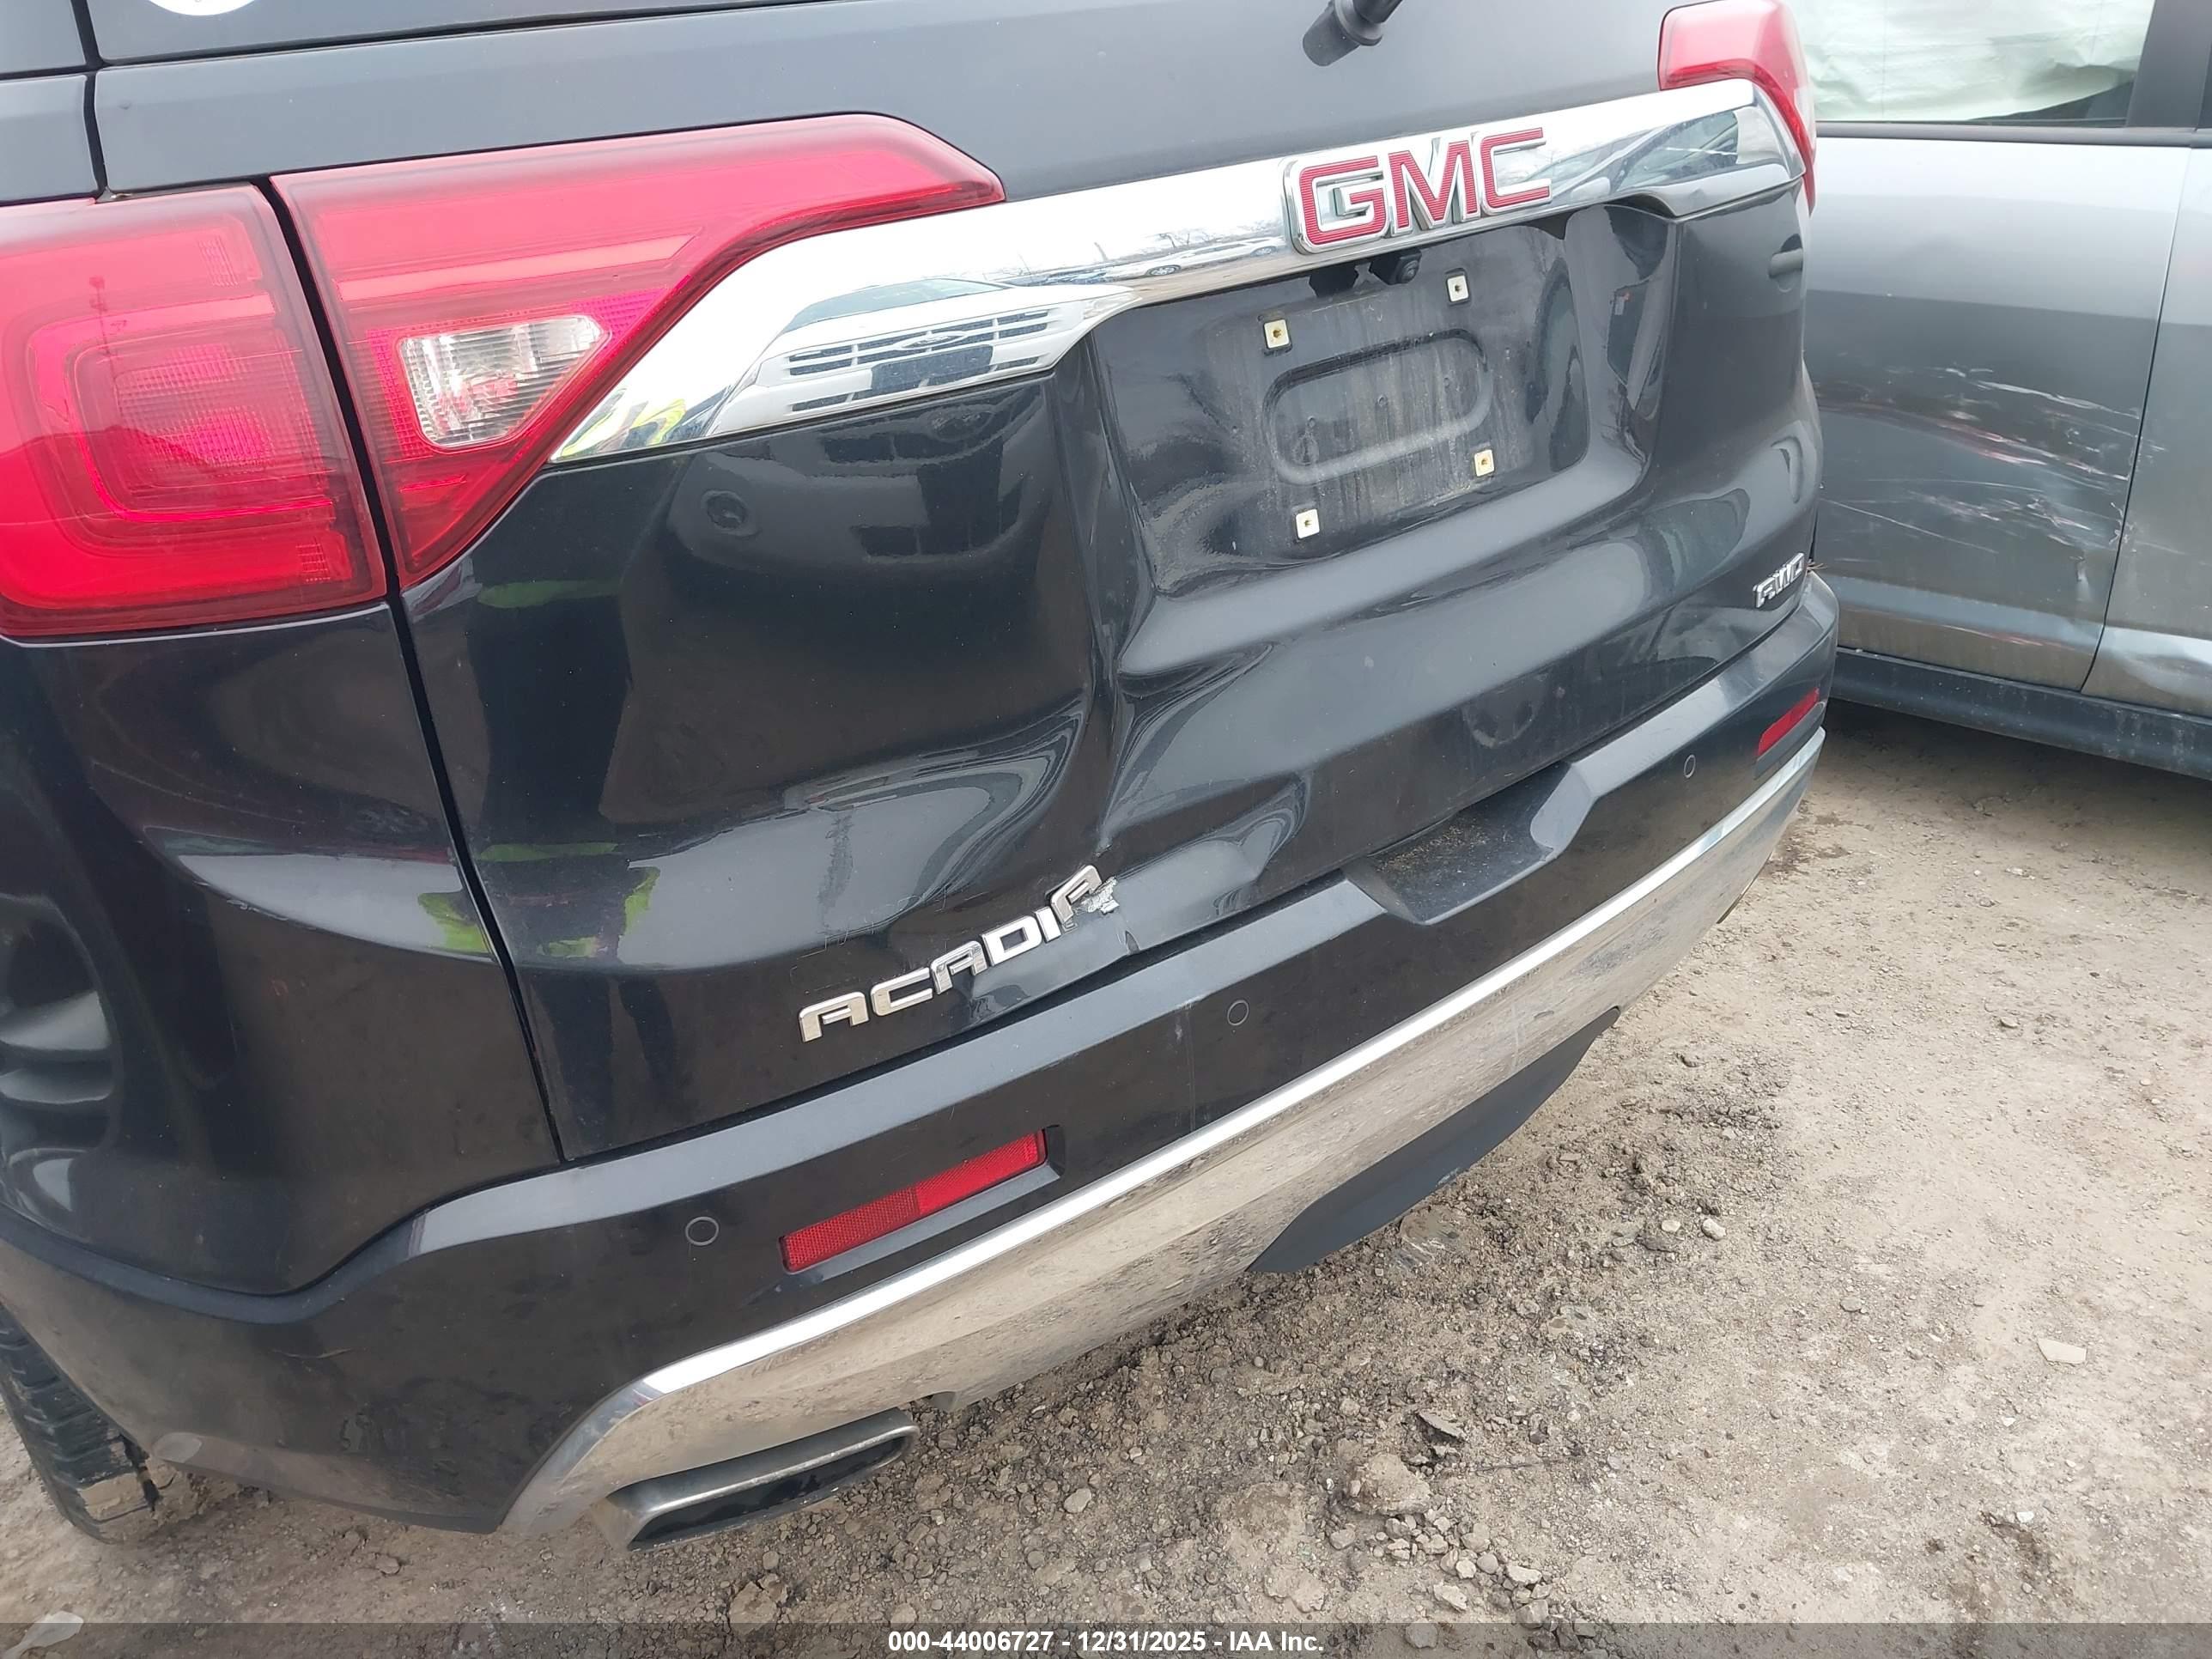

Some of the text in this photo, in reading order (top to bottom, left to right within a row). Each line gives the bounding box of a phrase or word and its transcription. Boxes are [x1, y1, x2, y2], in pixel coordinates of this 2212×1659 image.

[1290, 126, 1552, 251] GMC
[1753, 552, 1805, 608] AWD
[799, 865, 1112, 1042] ACADIA
